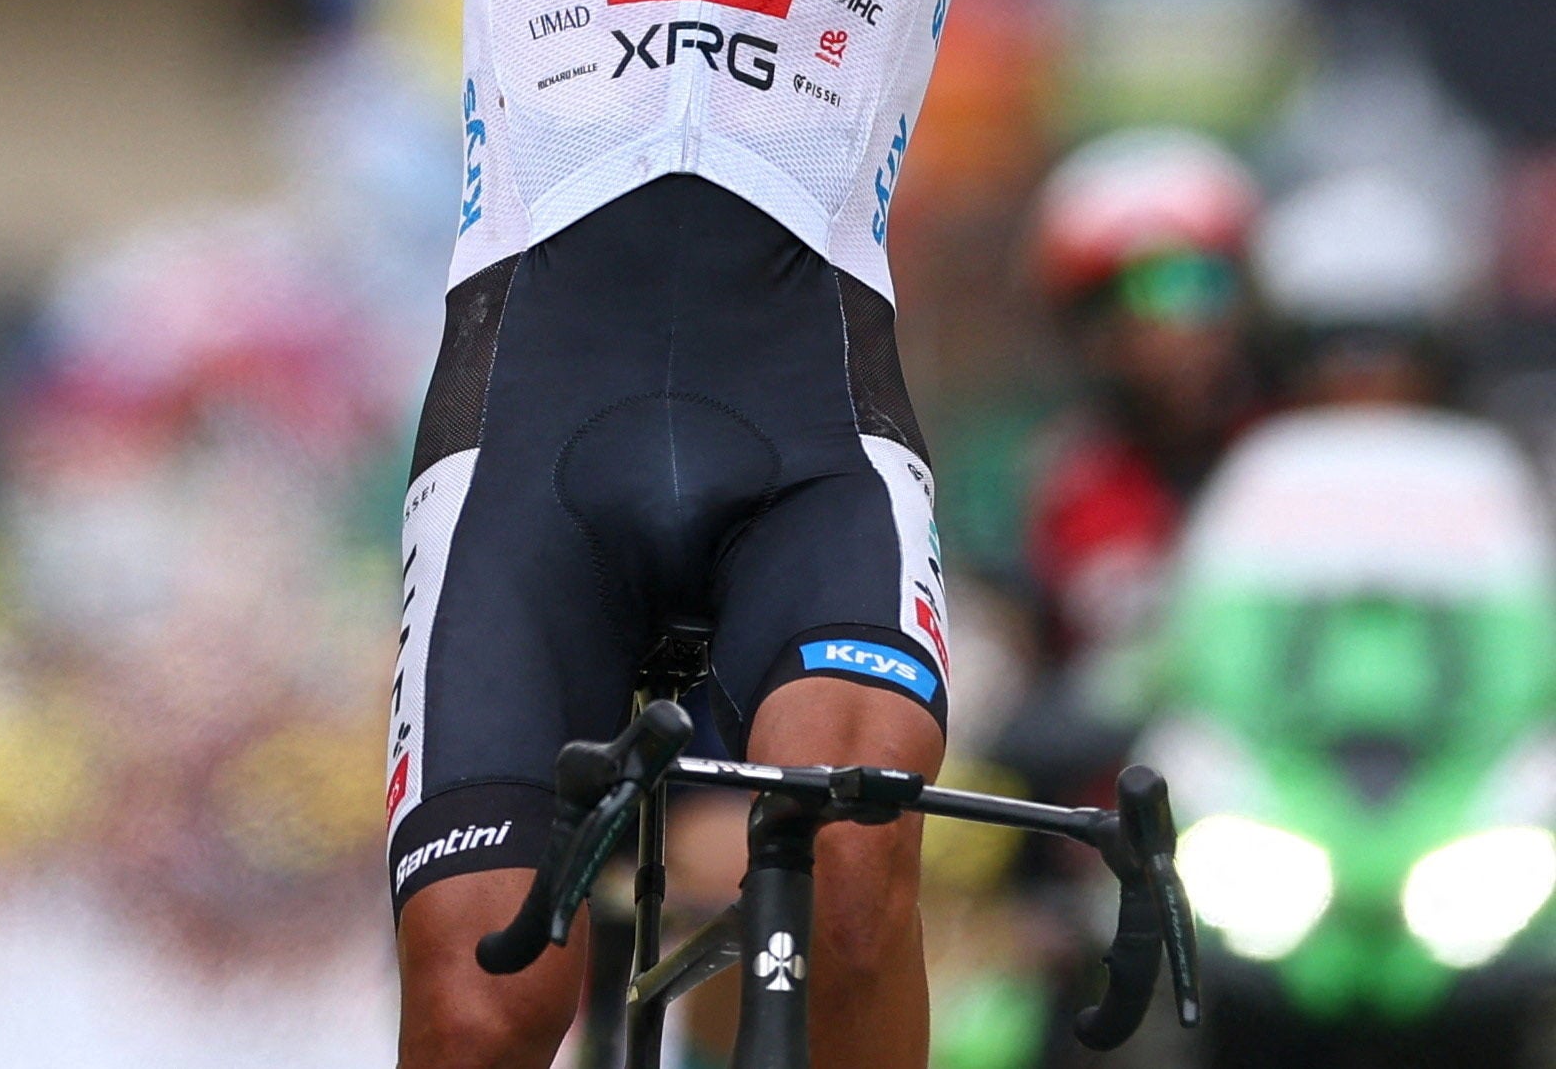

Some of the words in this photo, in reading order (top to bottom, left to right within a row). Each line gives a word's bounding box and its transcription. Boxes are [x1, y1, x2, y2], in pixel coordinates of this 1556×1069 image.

[529, 6, 590, 40] L'IMAD
[611, 21, 779, 91] XRG
[537, 70, 571, 91] RICHARD
[572, 63, 597, 78] MILLE
[805, 82, 841, 108] PISSEI
[826, 643, 917, 681] Krys
[396, 820, 512, 895] Santini
